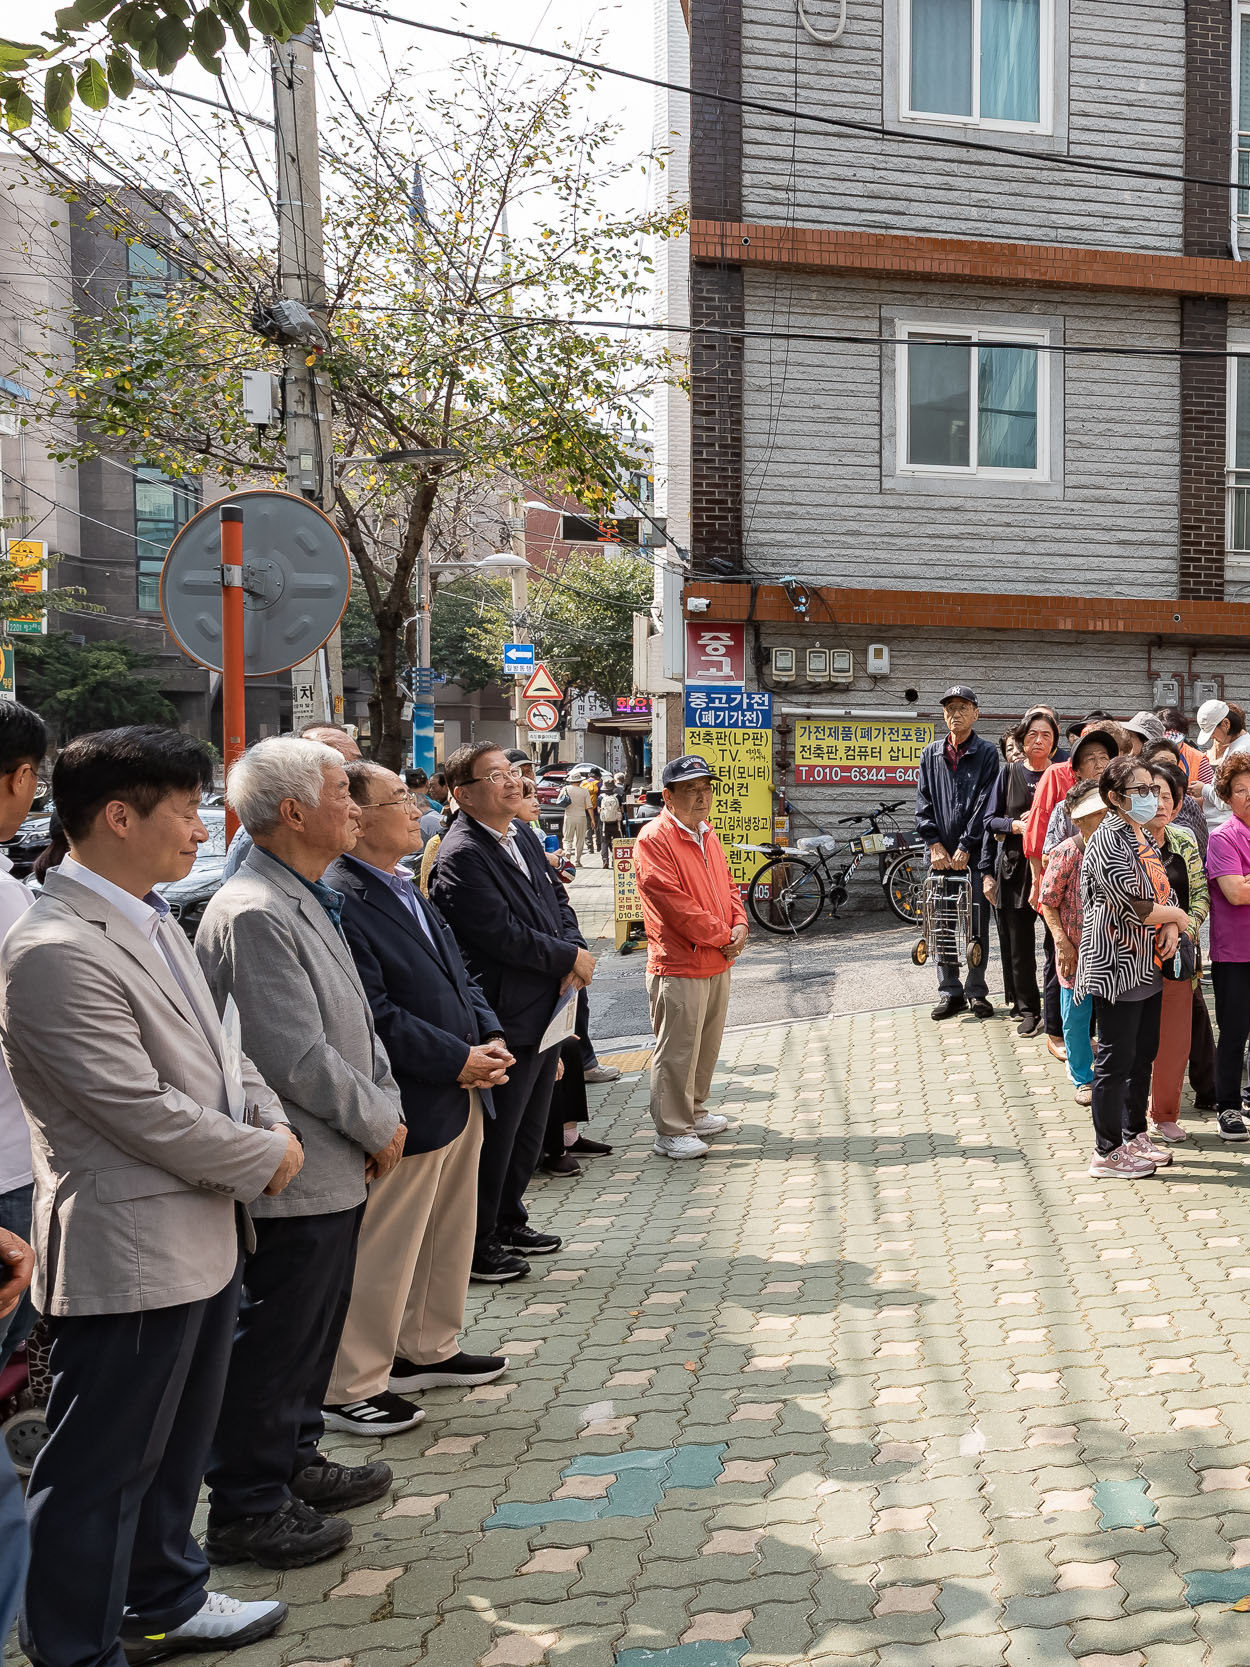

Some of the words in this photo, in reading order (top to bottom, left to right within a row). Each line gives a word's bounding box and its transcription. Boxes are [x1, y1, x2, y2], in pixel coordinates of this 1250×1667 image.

[695, 632, 736, 681] 중고
[506, 664, 532, 673] 일방통행
[688, 692, 769, 710] 중고가전
[695, 708, 763, 728] (폐기가전)
[689, 730, 769, 747] 전축판(LP판)
[799, 725, 932, 743] 가전제품(폐가전포함)
[799, 744, 882, 762] 전축판,컴퓨터
[715, 799, 742, 814] 전축
[706, 816, 772, 832] 고(김치냉장고)
[616, 848, 631, 858] 중고
[725, 850, 756, 865] 렌지
